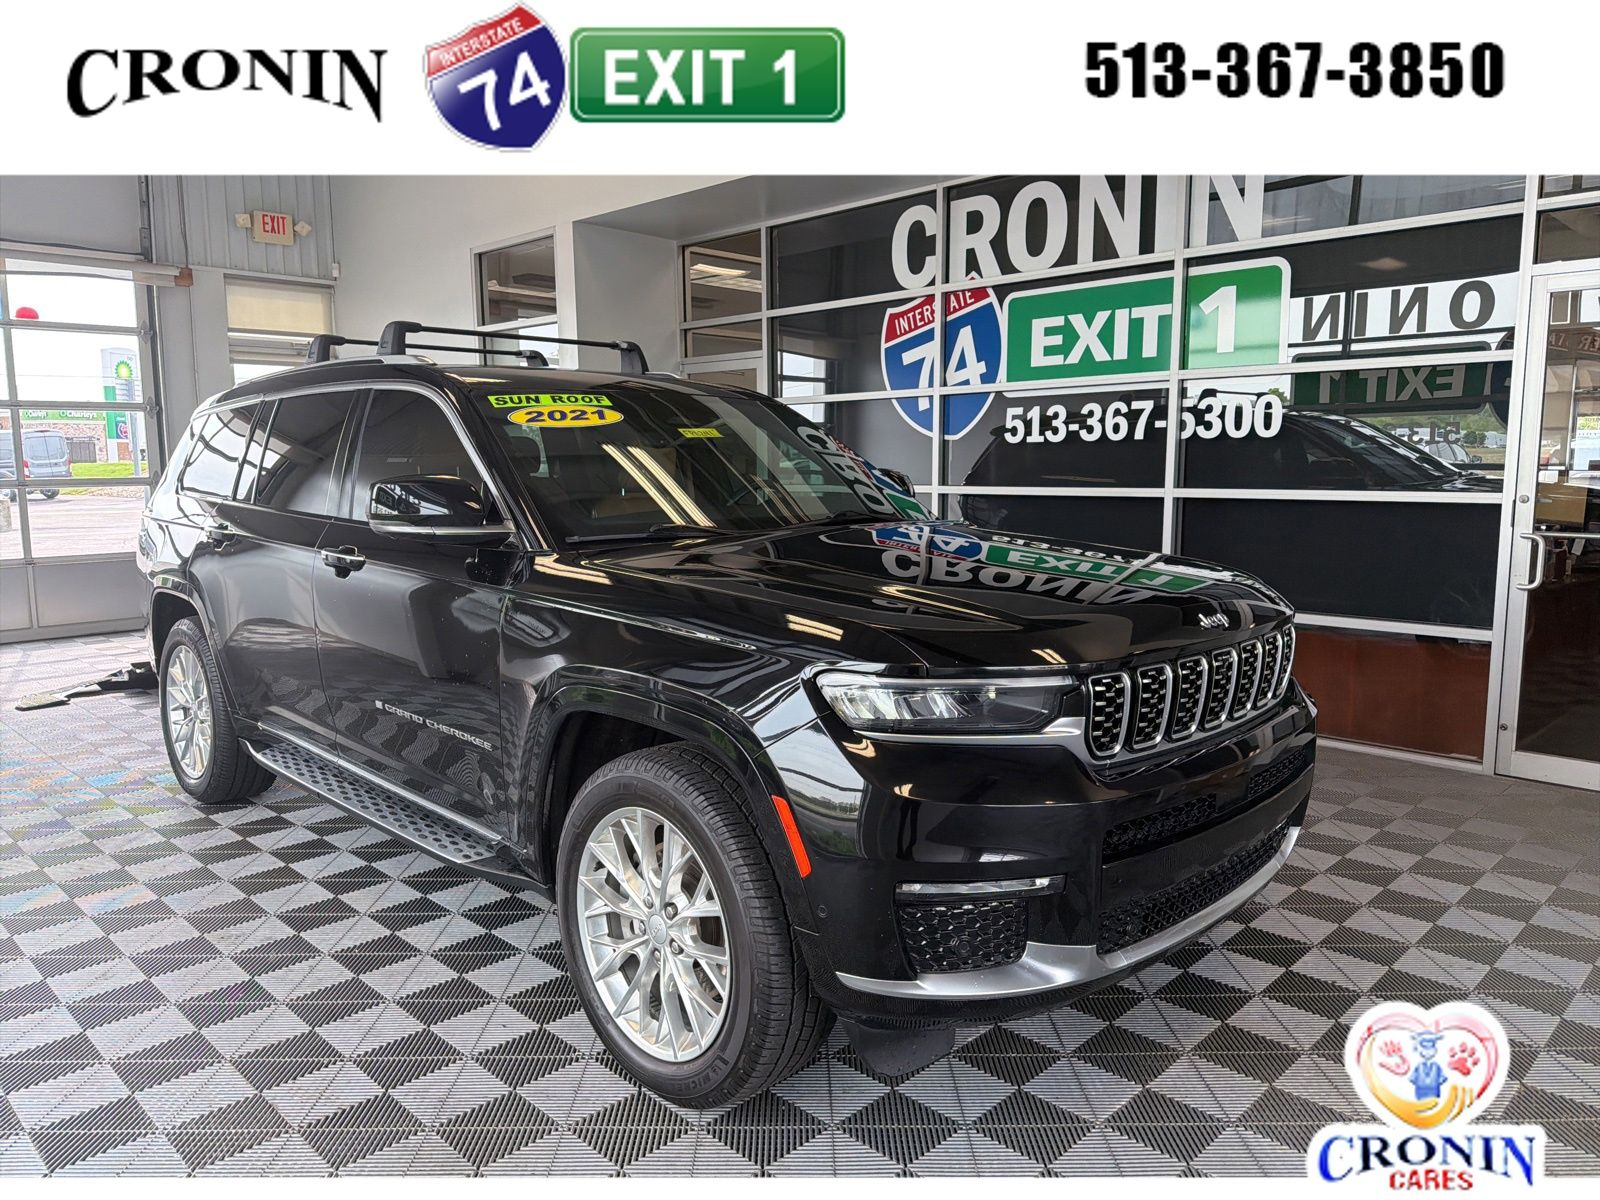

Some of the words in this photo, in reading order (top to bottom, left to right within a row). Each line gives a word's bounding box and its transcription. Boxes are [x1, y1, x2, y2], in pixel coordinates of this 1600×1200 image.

[262, 214, 287, 235] EXIT
[891, 174, 1264, 290] CRONIN
[1030, 303, 1172, 368] EXIT
[1199, 285, 1237, 354] 1
[902, 325, 987, 412] 74
[495, 395, 540, 405] SUN
[552, 395, 604, 404] ROOF
[525, 410, 607, 423] 2021
[1198, 613, 1230, 630] Jeep
[384, 703, 424, 724] GRAND
[425, 719, 493, 752] CHEROKEE
